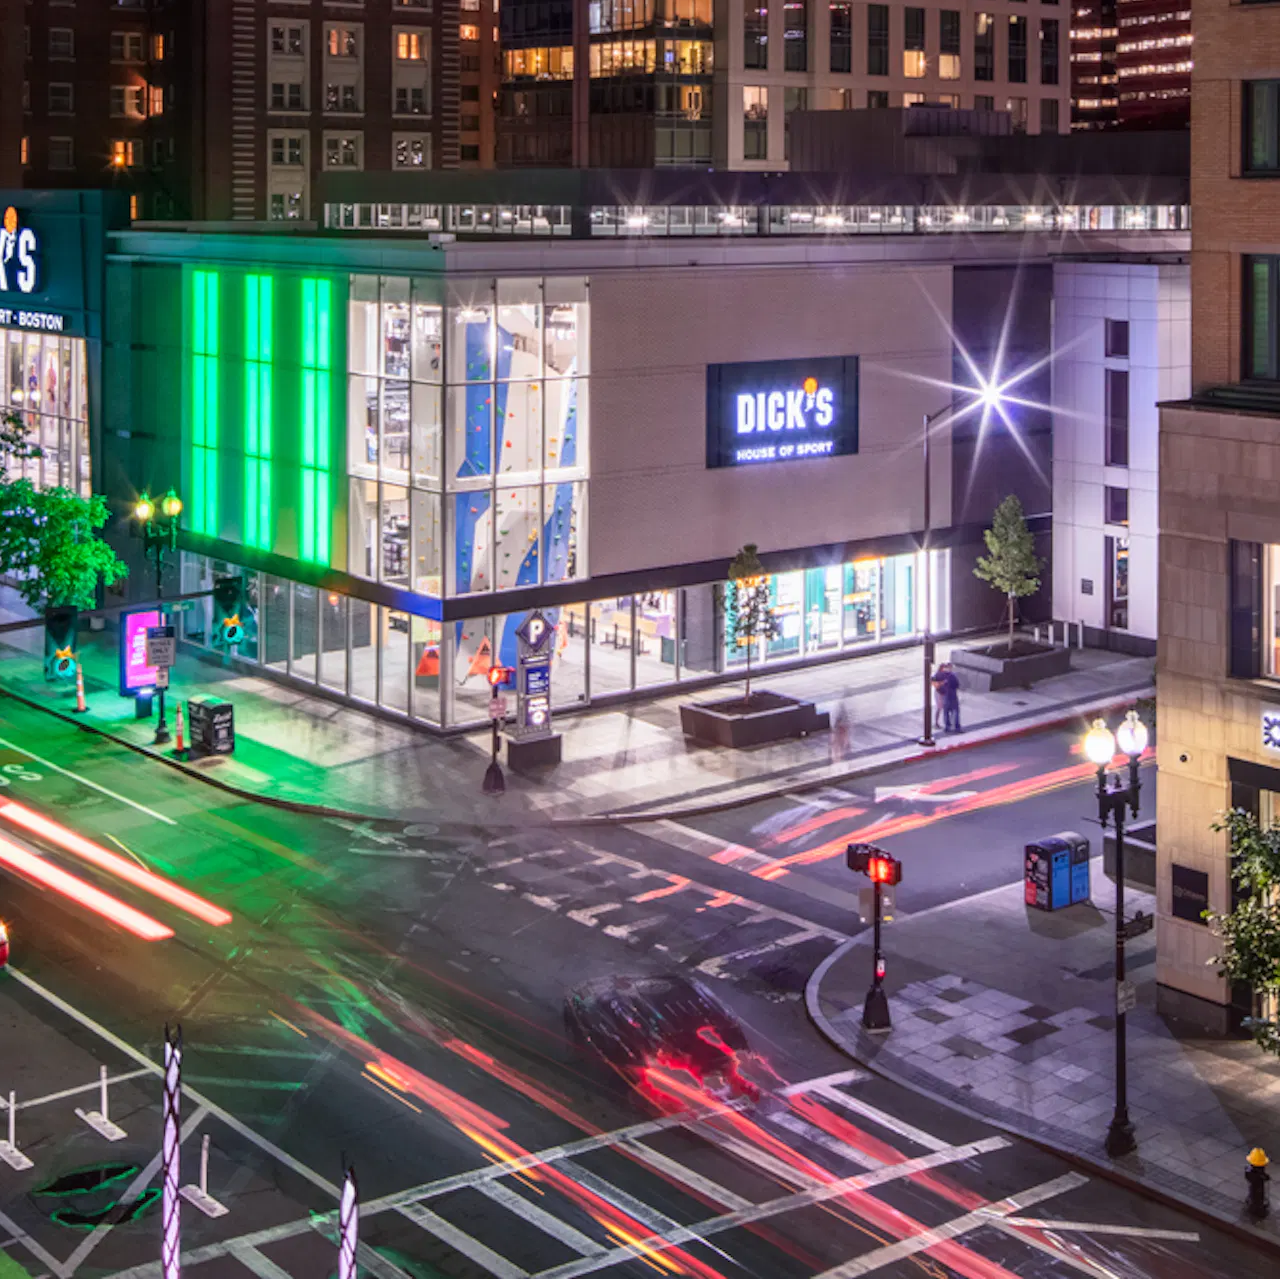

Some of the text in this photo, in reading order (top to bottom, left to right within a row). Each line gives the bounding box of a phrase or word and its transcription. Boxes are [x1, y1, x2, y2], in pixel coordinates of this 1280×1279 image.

[18, 311, 64, 332] BOSTON
[736, 440, 834, 461] HOUSE OF SPORT
[529, 620, 545, 644] P
